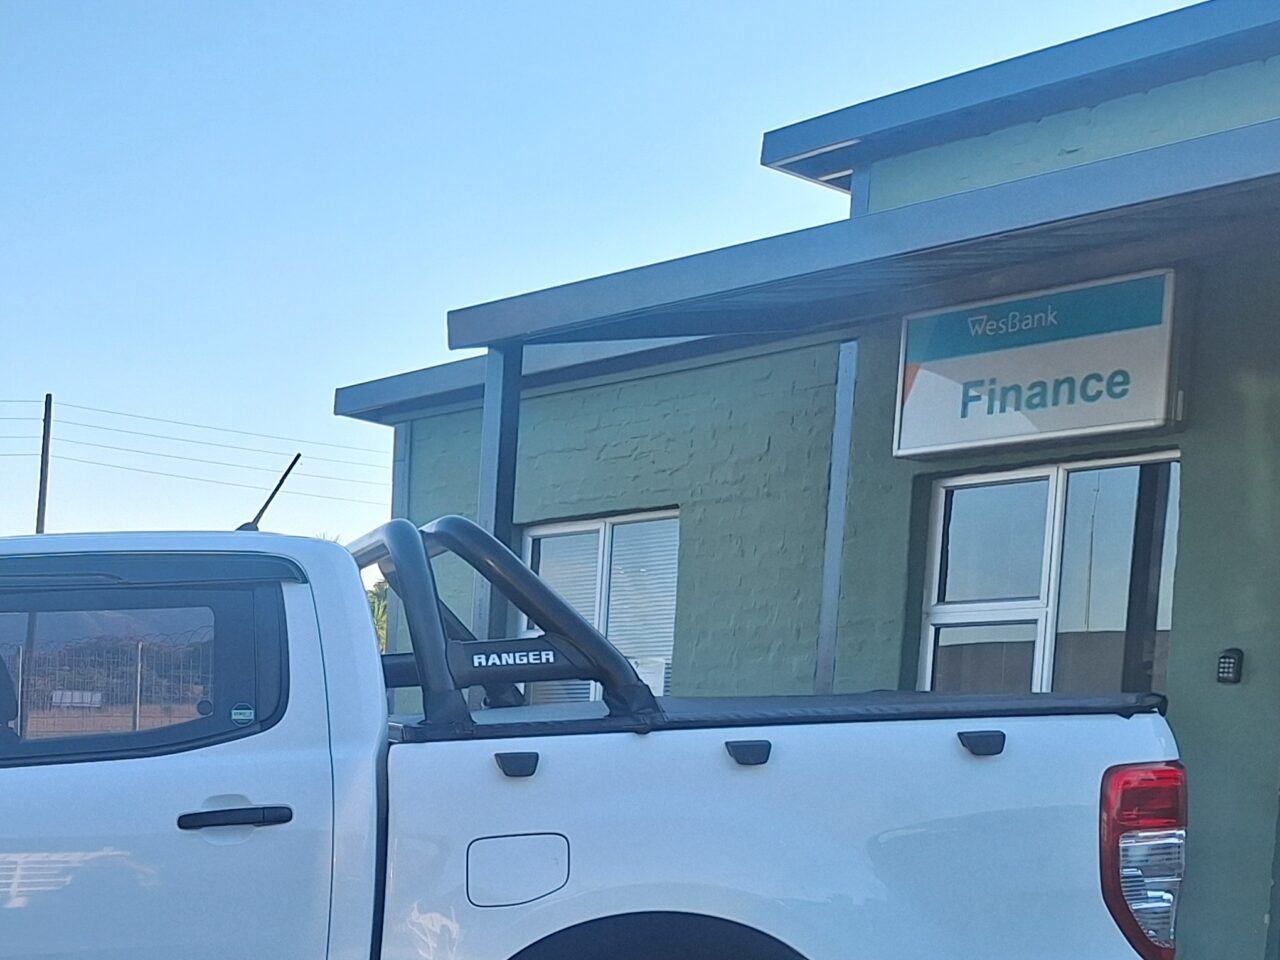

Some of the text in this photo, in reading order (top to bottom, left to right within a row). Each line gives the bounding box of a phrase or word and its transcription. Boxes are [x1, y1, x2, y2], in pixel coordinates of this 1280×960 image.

[968, 305, 1058, 336] WesBank
[960, 369, 1131, 418] Finance
[473, 651, 554, 667] RANGER
